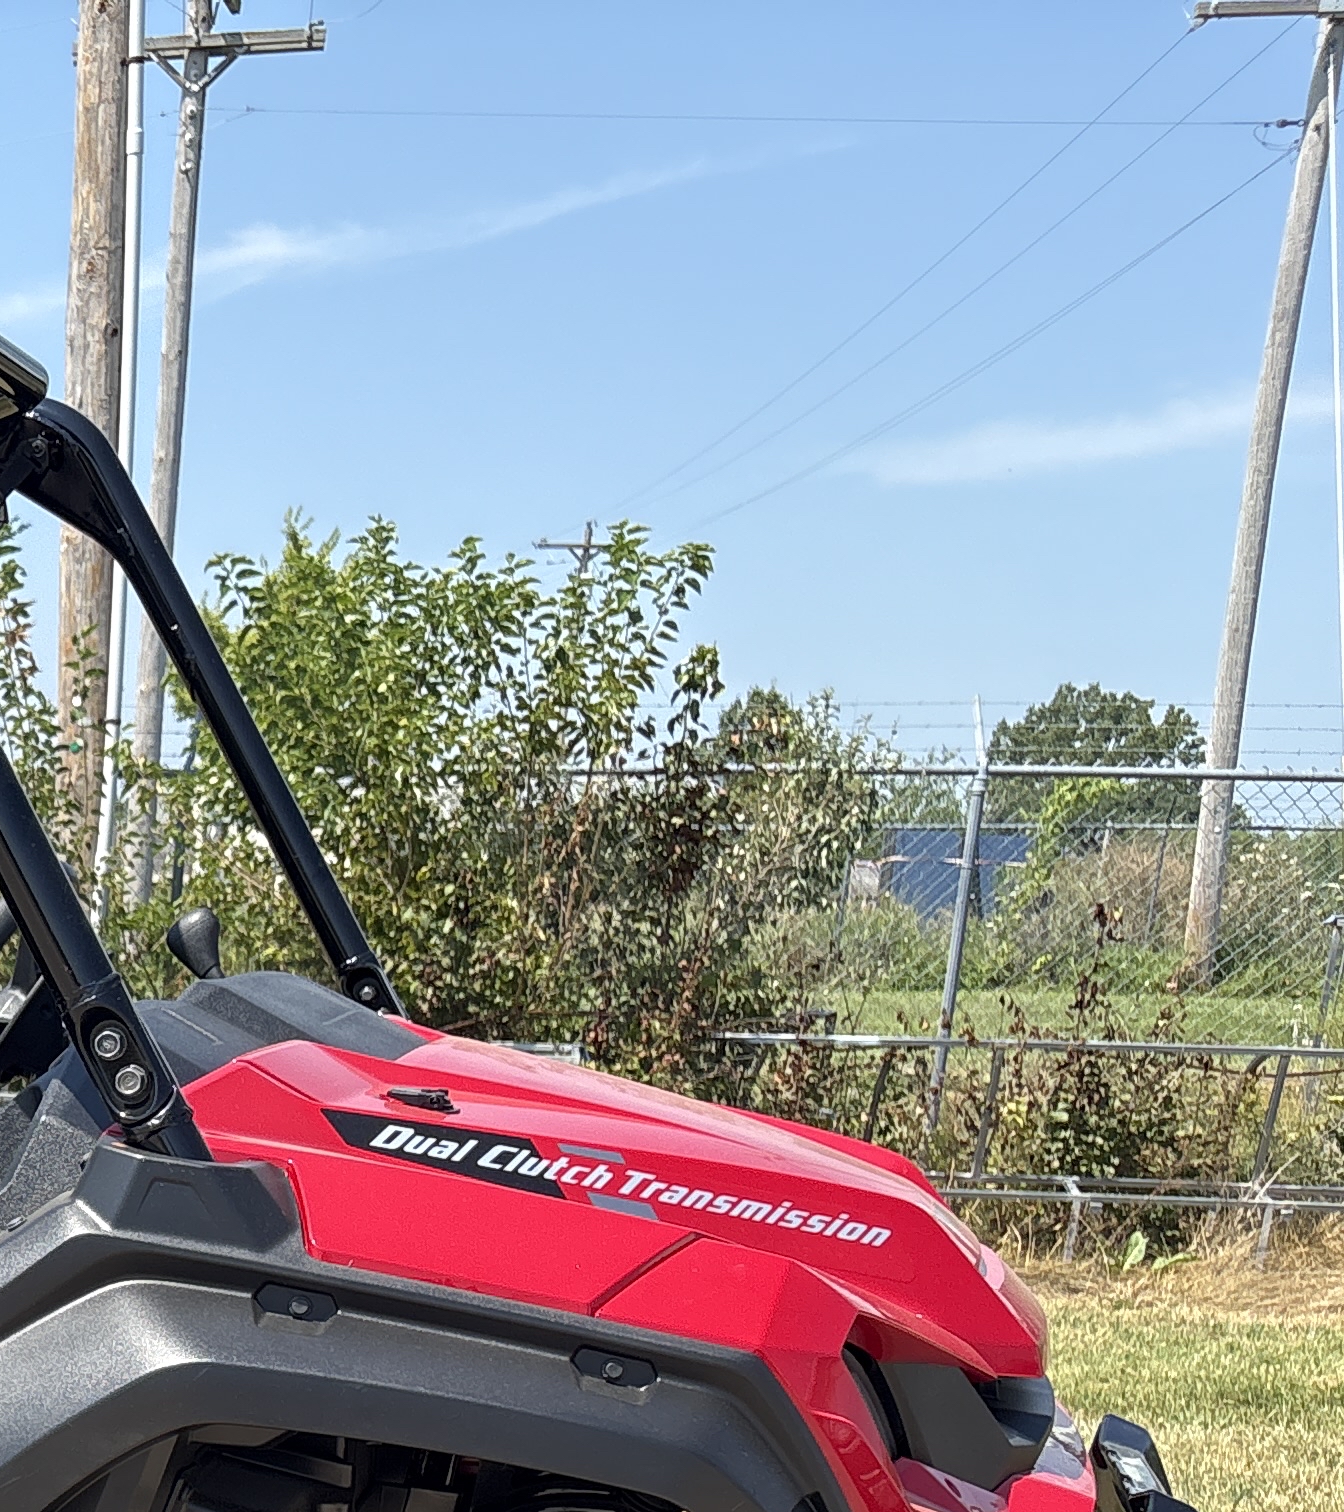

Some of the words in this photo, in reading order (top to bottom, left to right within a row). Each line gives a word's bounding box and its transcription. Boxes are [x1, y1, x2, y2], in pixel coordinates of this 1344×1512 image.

[369, 1124, 475, 1163] Dual
[476, 1143, 614, 1189] Clutch
[619, 1170, 892, 1248] Transmission
